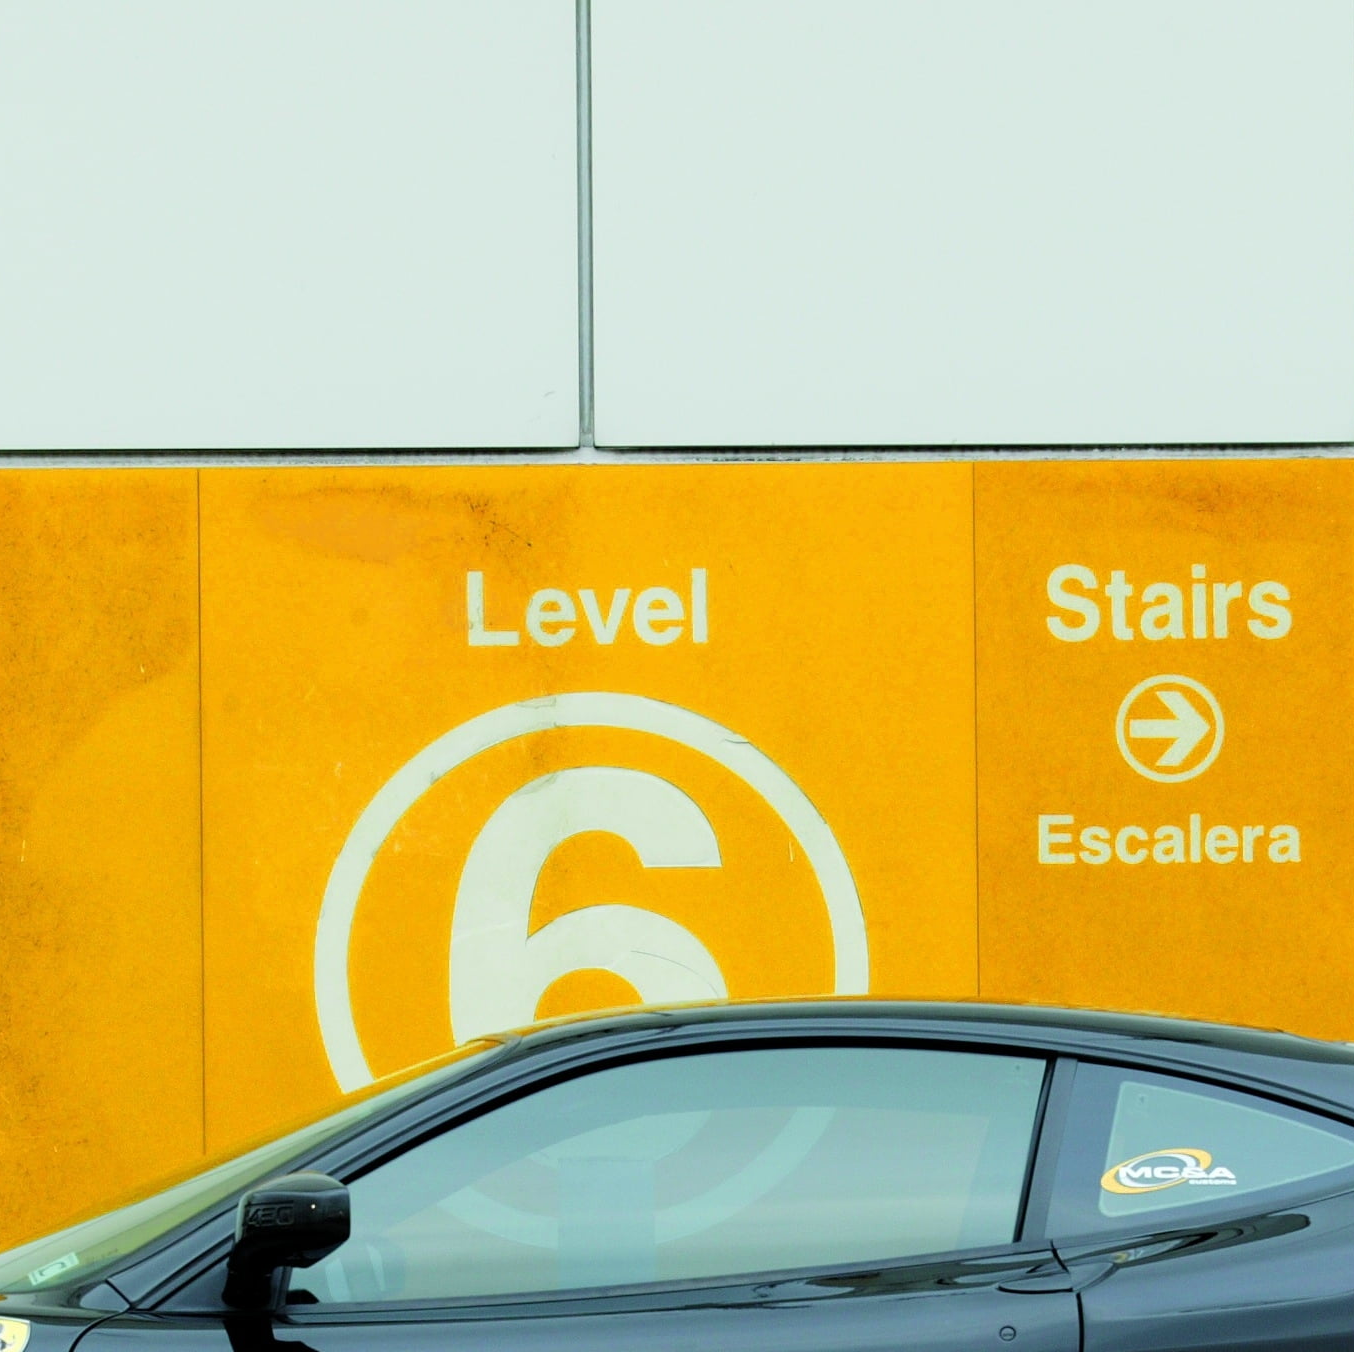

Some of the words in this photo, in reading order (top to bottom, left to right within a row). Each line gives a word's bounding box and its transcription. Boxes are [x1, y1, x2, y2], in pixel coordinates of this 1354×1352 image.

[467, 568, 708, 647] Level
[1046, 564, 1293, 642] Stairs
[1037, 814, 1301, 865] Escalera
[448, 765, 728, 1044] 6
